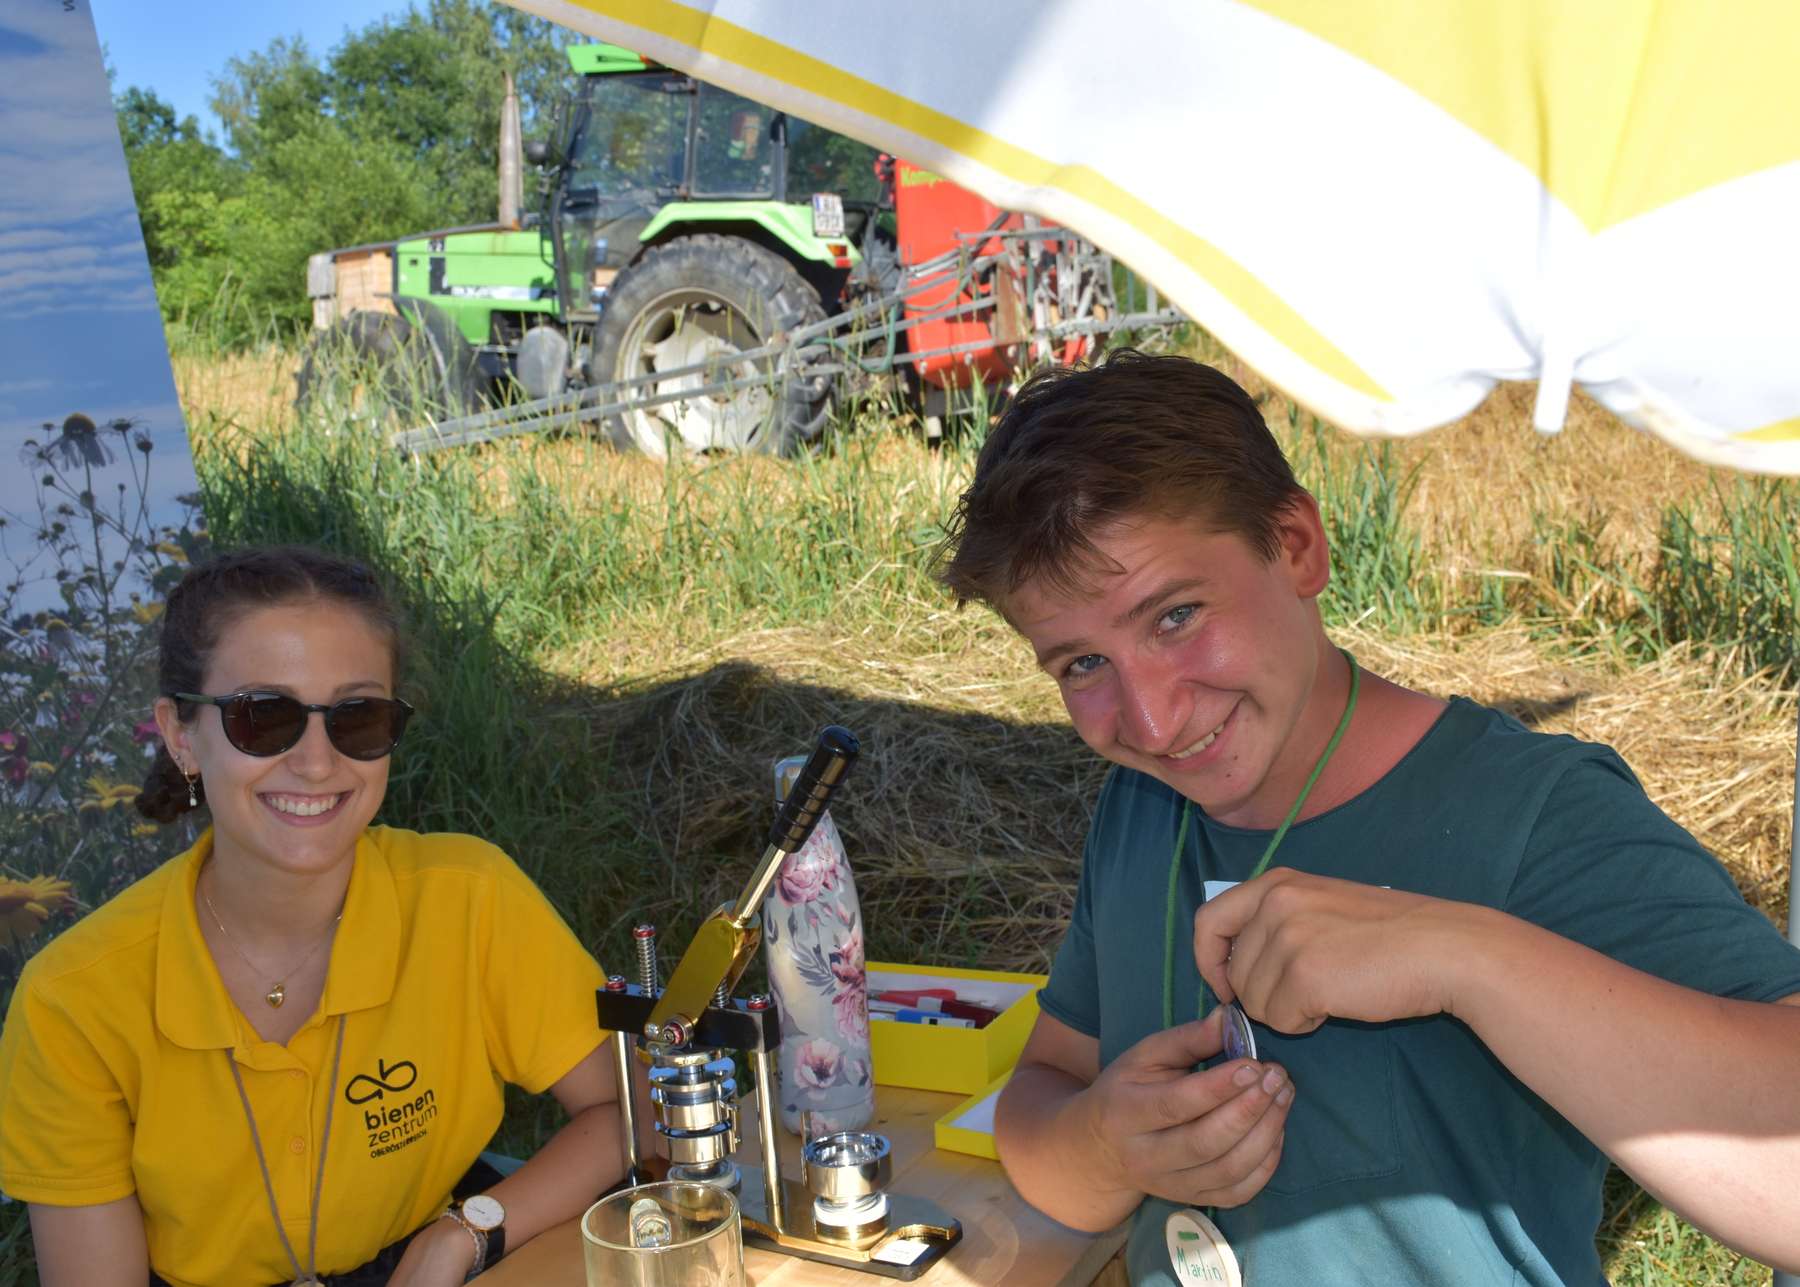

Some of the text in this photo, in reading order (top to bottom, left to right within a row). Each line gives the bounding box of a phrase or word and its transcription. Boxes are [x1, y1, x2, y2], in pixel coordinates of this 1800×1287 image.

[365, 1089, 435, 1131] bienen
[368, 1104, 438, 1148] zentrum
[1176, 1245, 1223, 1281] Martin
